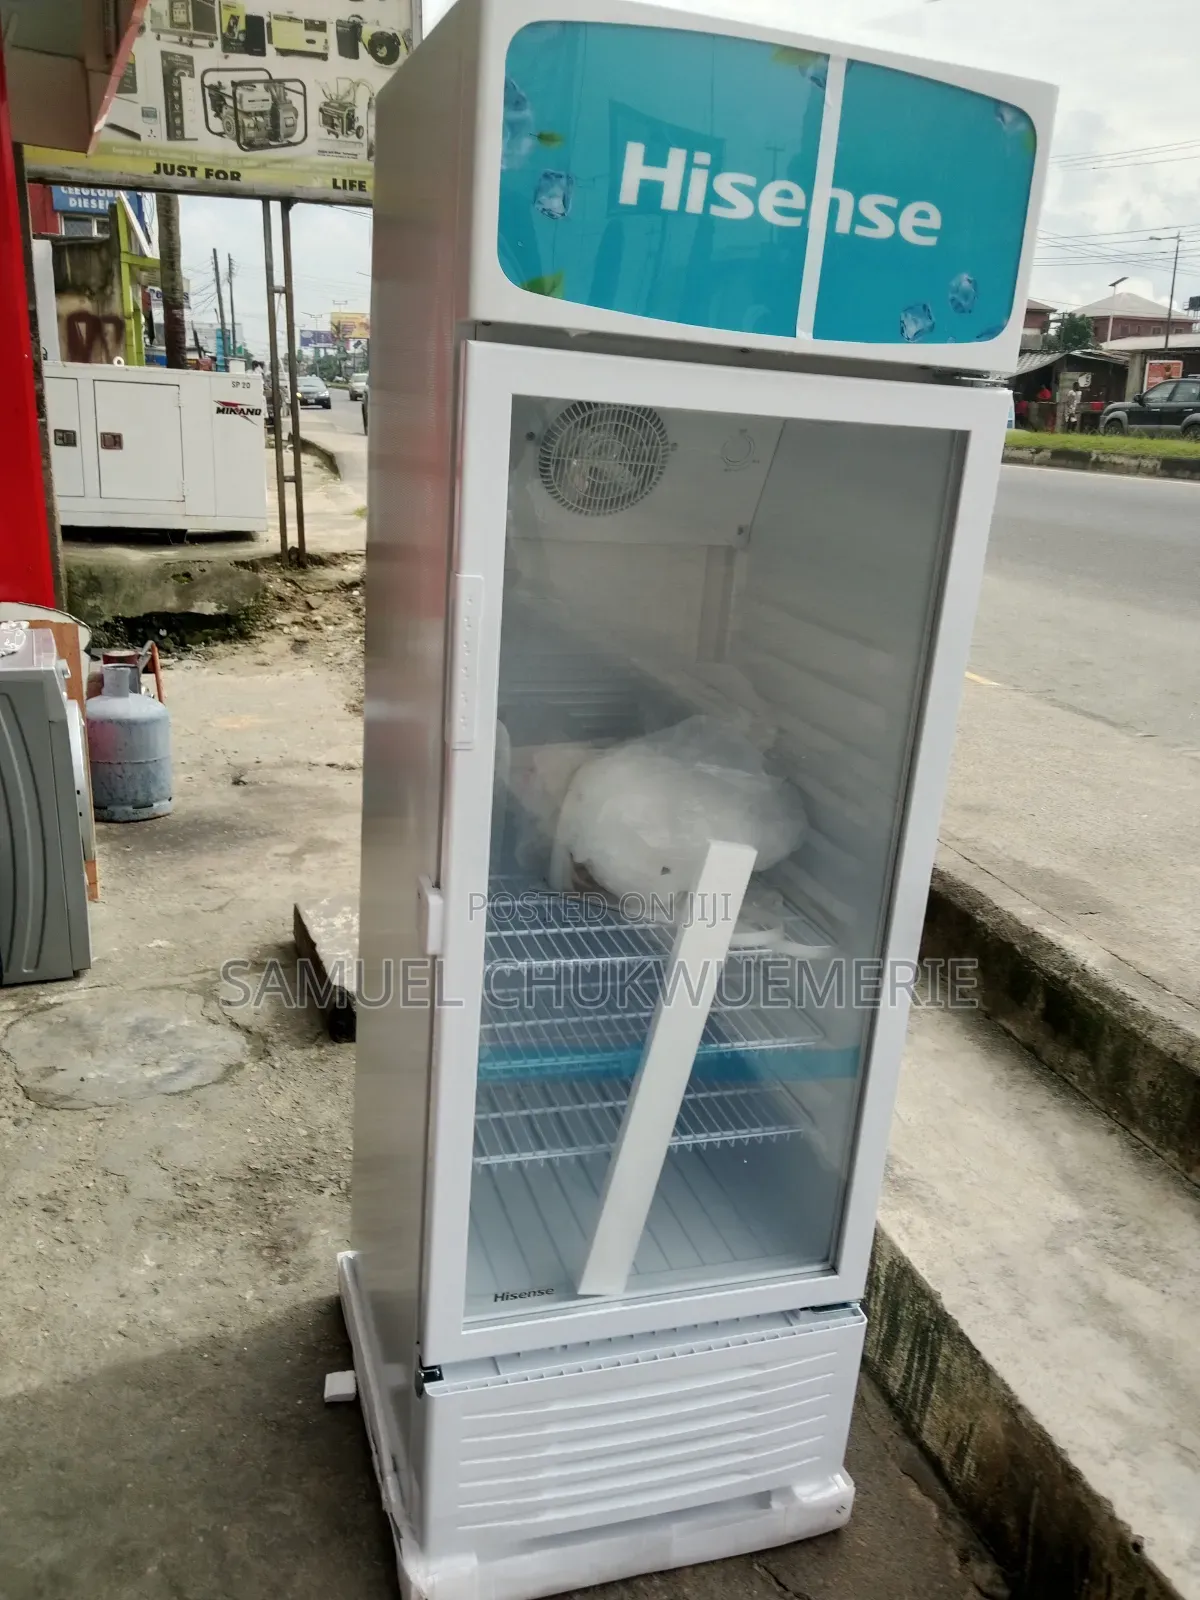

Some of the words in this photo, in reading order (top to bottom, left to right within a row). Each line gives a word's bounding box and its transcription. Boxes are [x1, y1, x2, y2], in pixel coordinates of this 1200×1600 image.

[153, 162, 198, 178] JUST
[205, 168, 242, 181] FOR
[332, 178, 367, 192] LIFE
[619, 141, 942, 246] Hisense
[216, 406, 262, 416] MIKANO
[493, 1287, 555, 1303] Hisense
